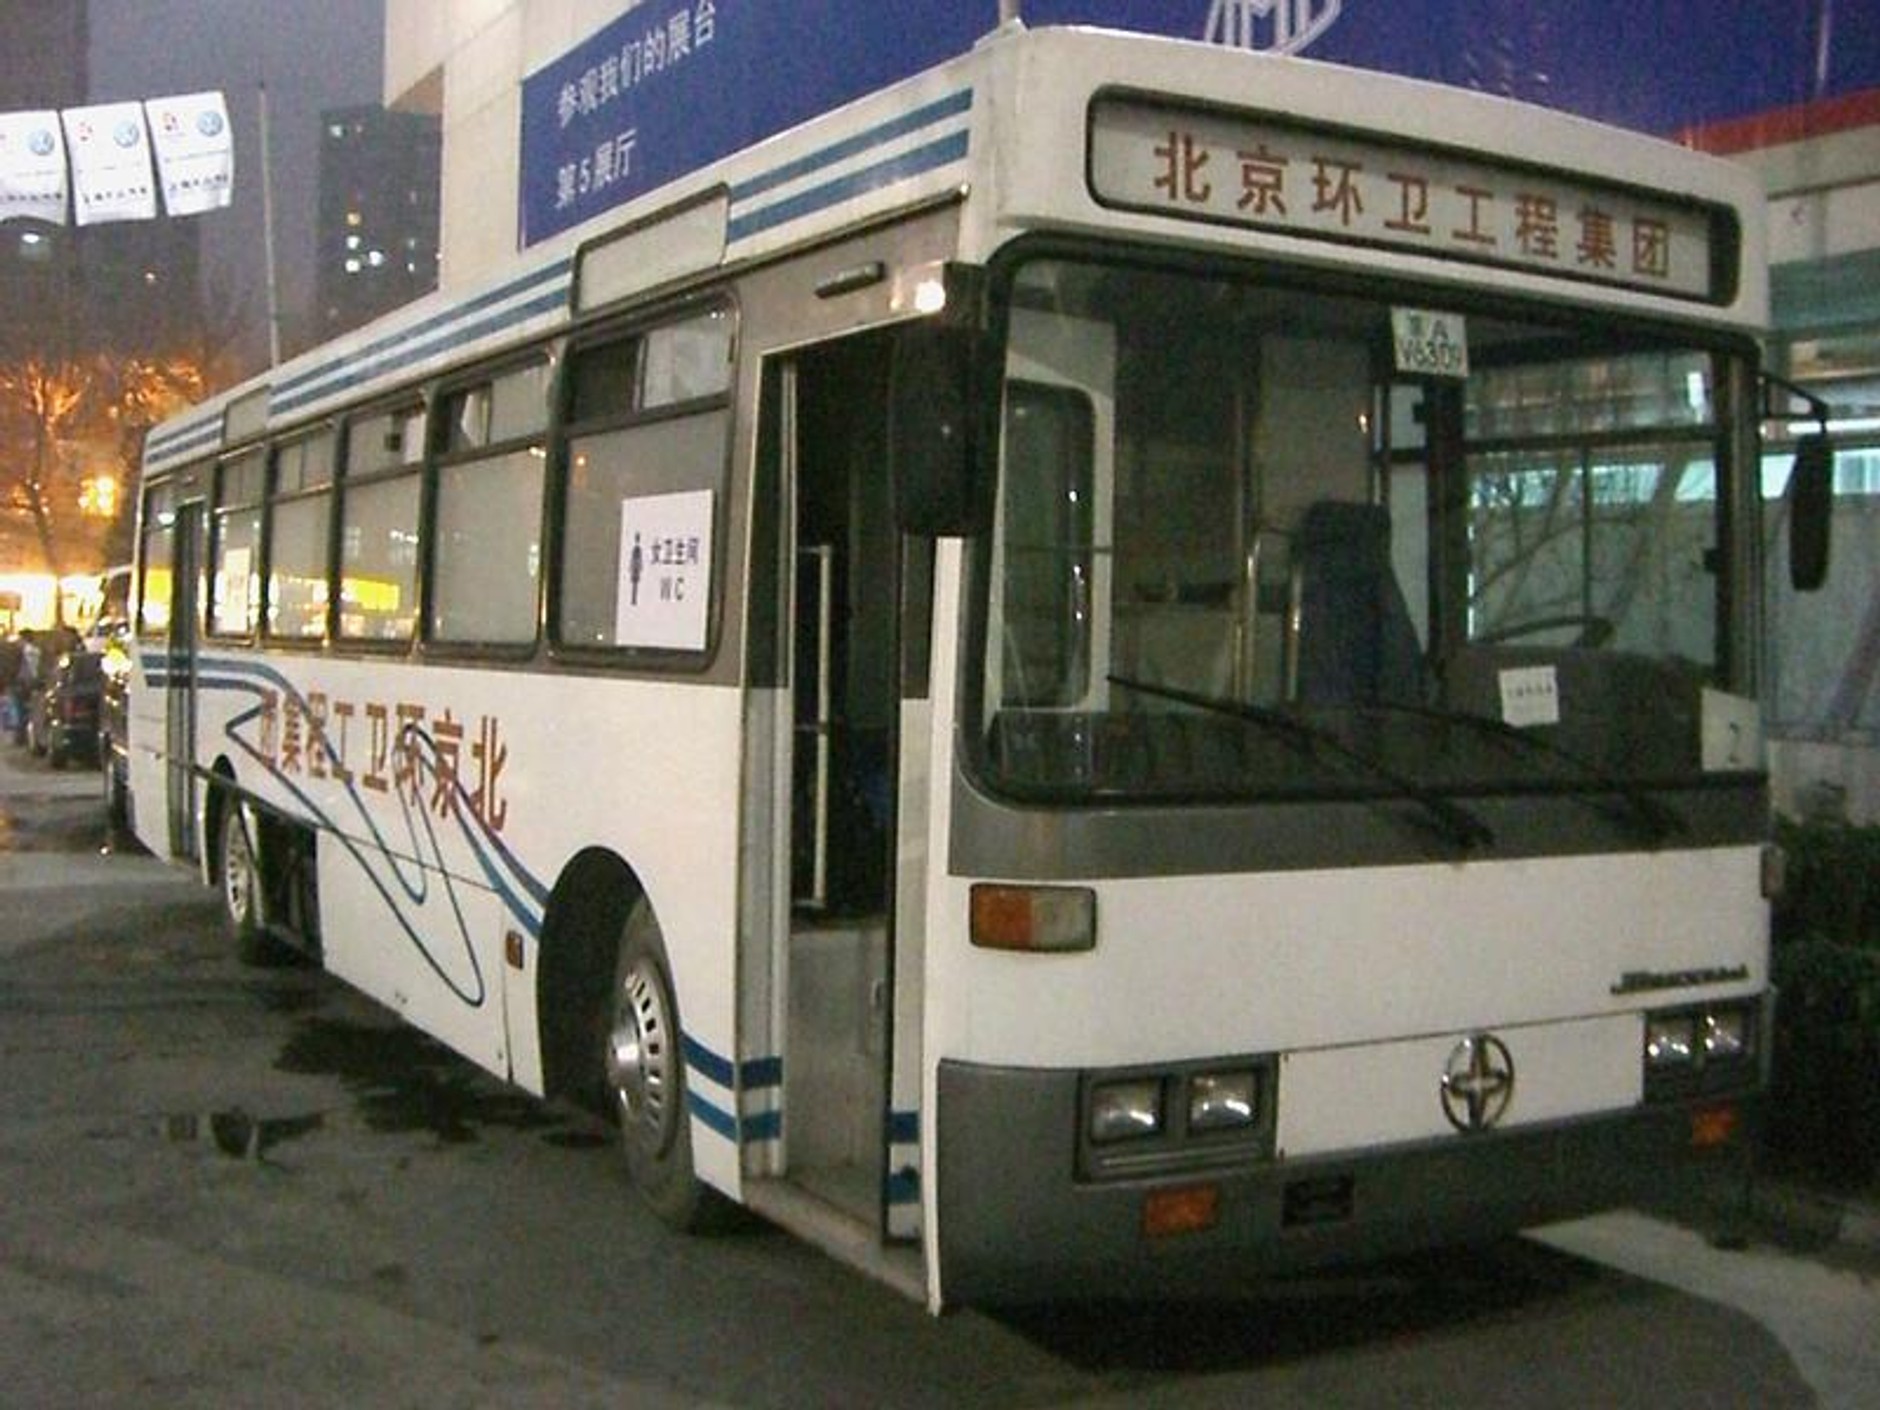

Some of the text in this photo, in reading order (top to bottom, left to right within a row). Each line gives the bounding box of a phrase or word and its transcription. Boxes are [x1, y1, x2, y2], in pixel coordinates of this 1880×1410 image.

[1153, 130, 1673, 279] 北京环卫工程集团
[651, 536, 700, 565] 女卫生间
